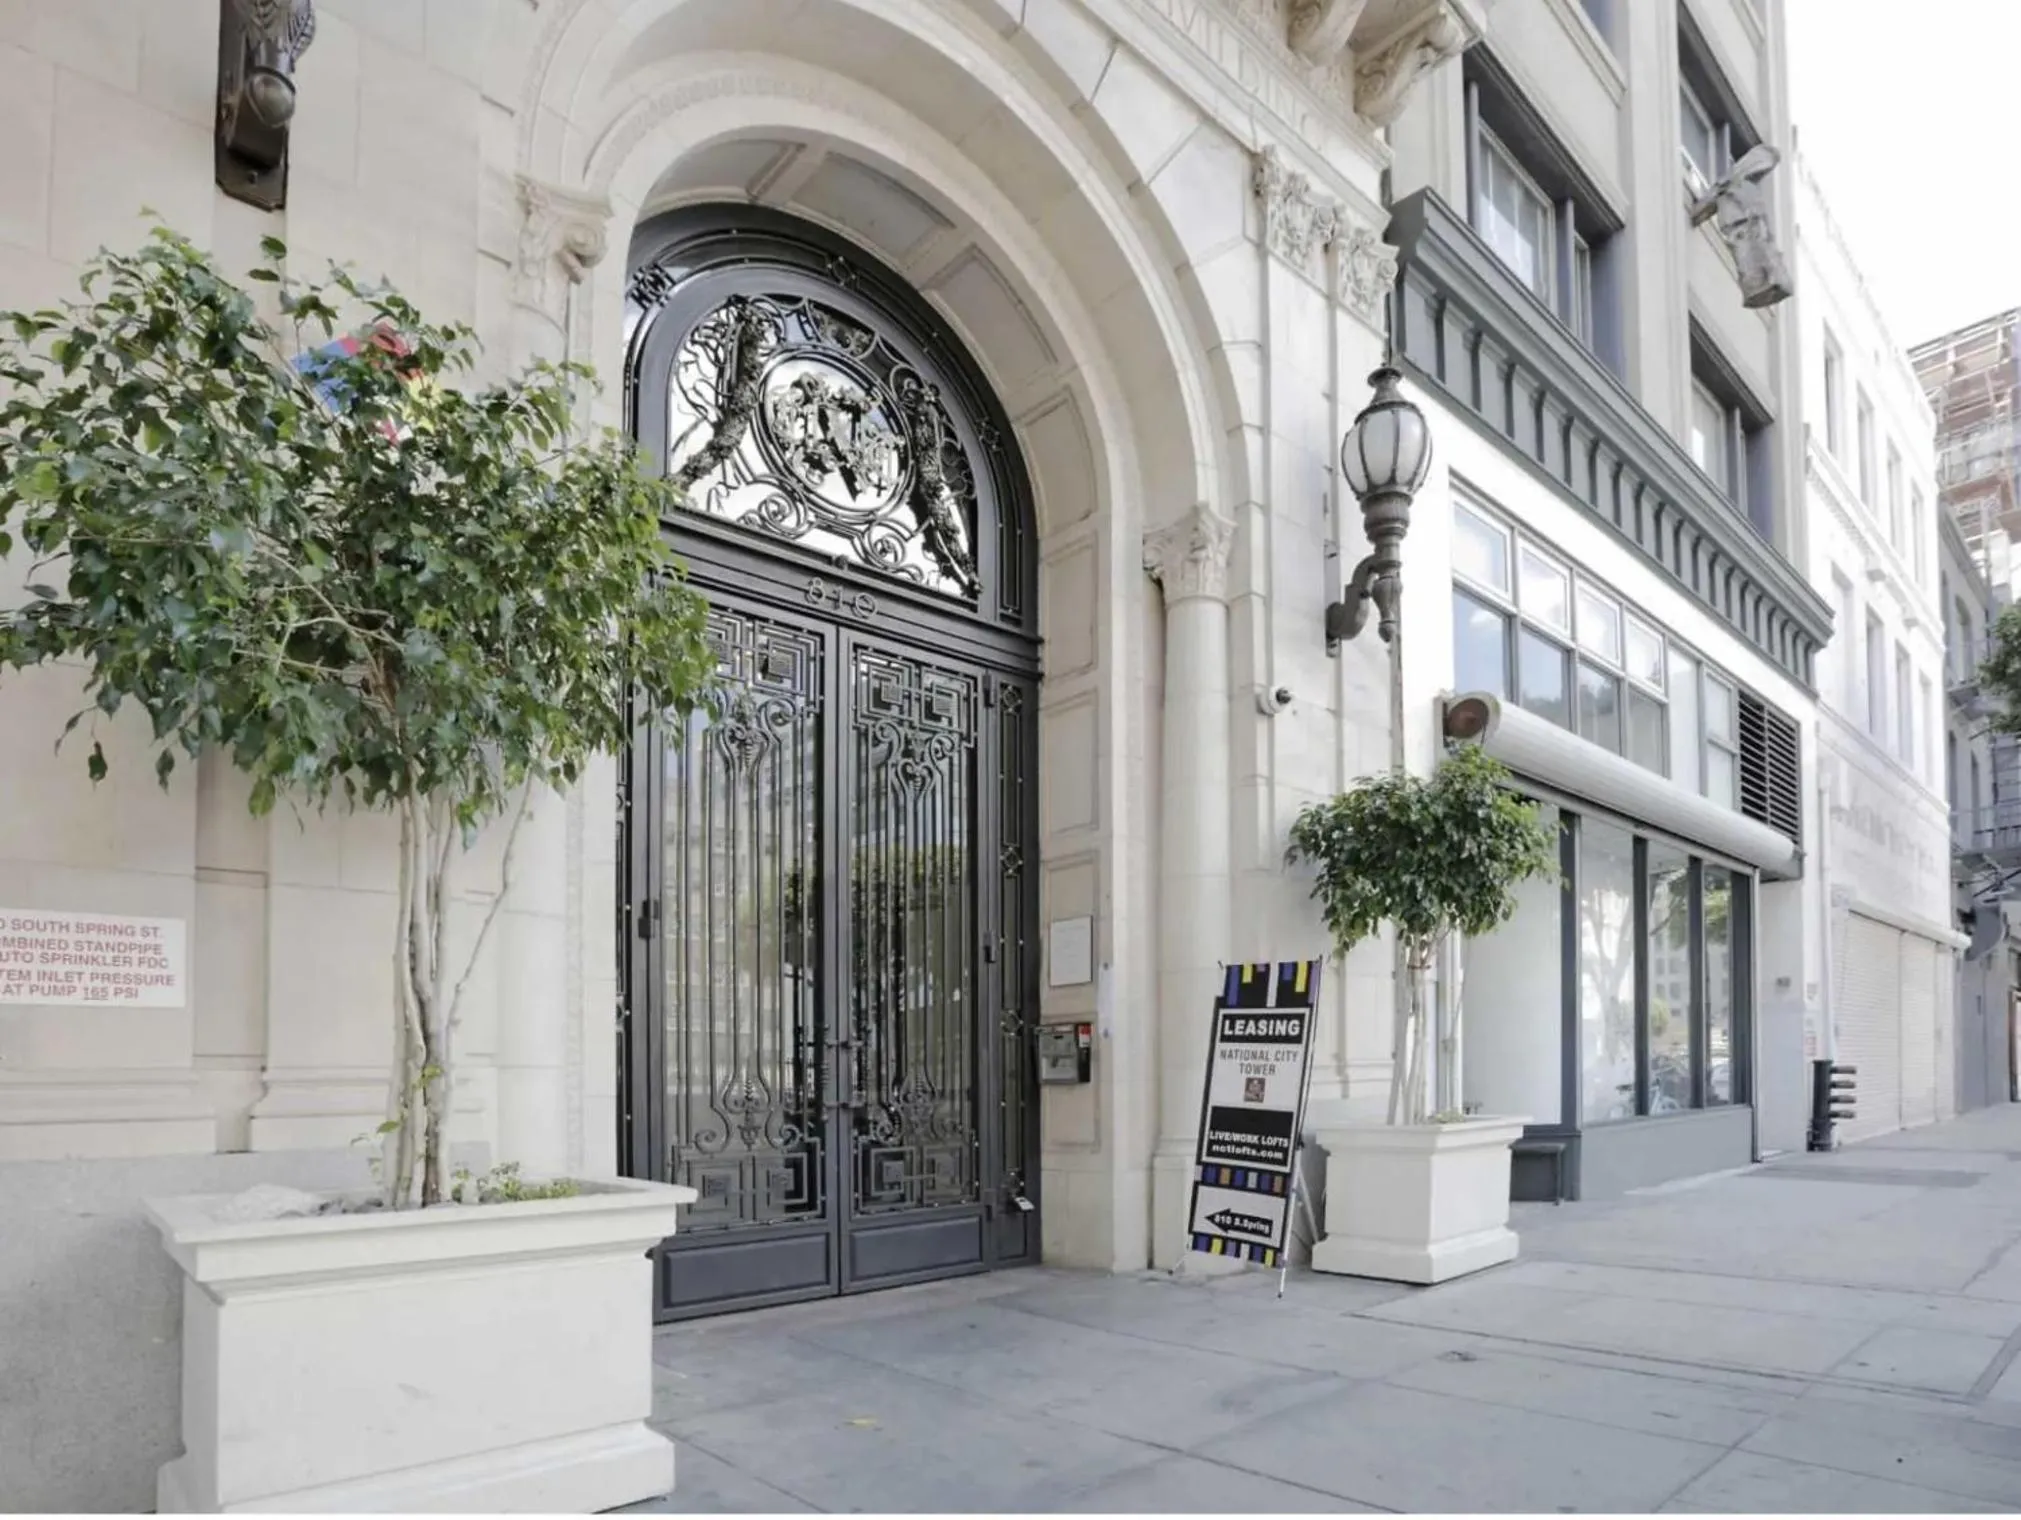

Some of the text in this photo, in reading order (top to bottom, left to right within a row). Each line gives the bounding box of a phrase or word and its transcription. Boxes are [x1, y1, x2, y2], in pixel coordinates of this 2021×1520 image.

[808, 577, 877, 619] 810
[11, 918, 70, 934] SOUTH
[75, 923, 136, 938] SPRING
[140, 925, 164, 939] ST.
[0, 937, 163, 956] MBINED STANDPIPE
[39, 952, 133, 968] SPRINKLER
[138, 956, 169, 970] FDC
[37, 970, 86, 984] INLET
[89, 972, 176, 987] PRESSURE
[1, 984, 139, 1000] AT PUMP 165 PSI
[1224, 1019, 1300, 1035] LEASING
[1220, 1049, 1299, 1062] NATIONAL CITY
[1239, 1063, 1276, 1076] TOWER
[1261, 1135, 1289, 1148] LOFTS
[1212, 1144, 1283, 1159] nctlofts.com
